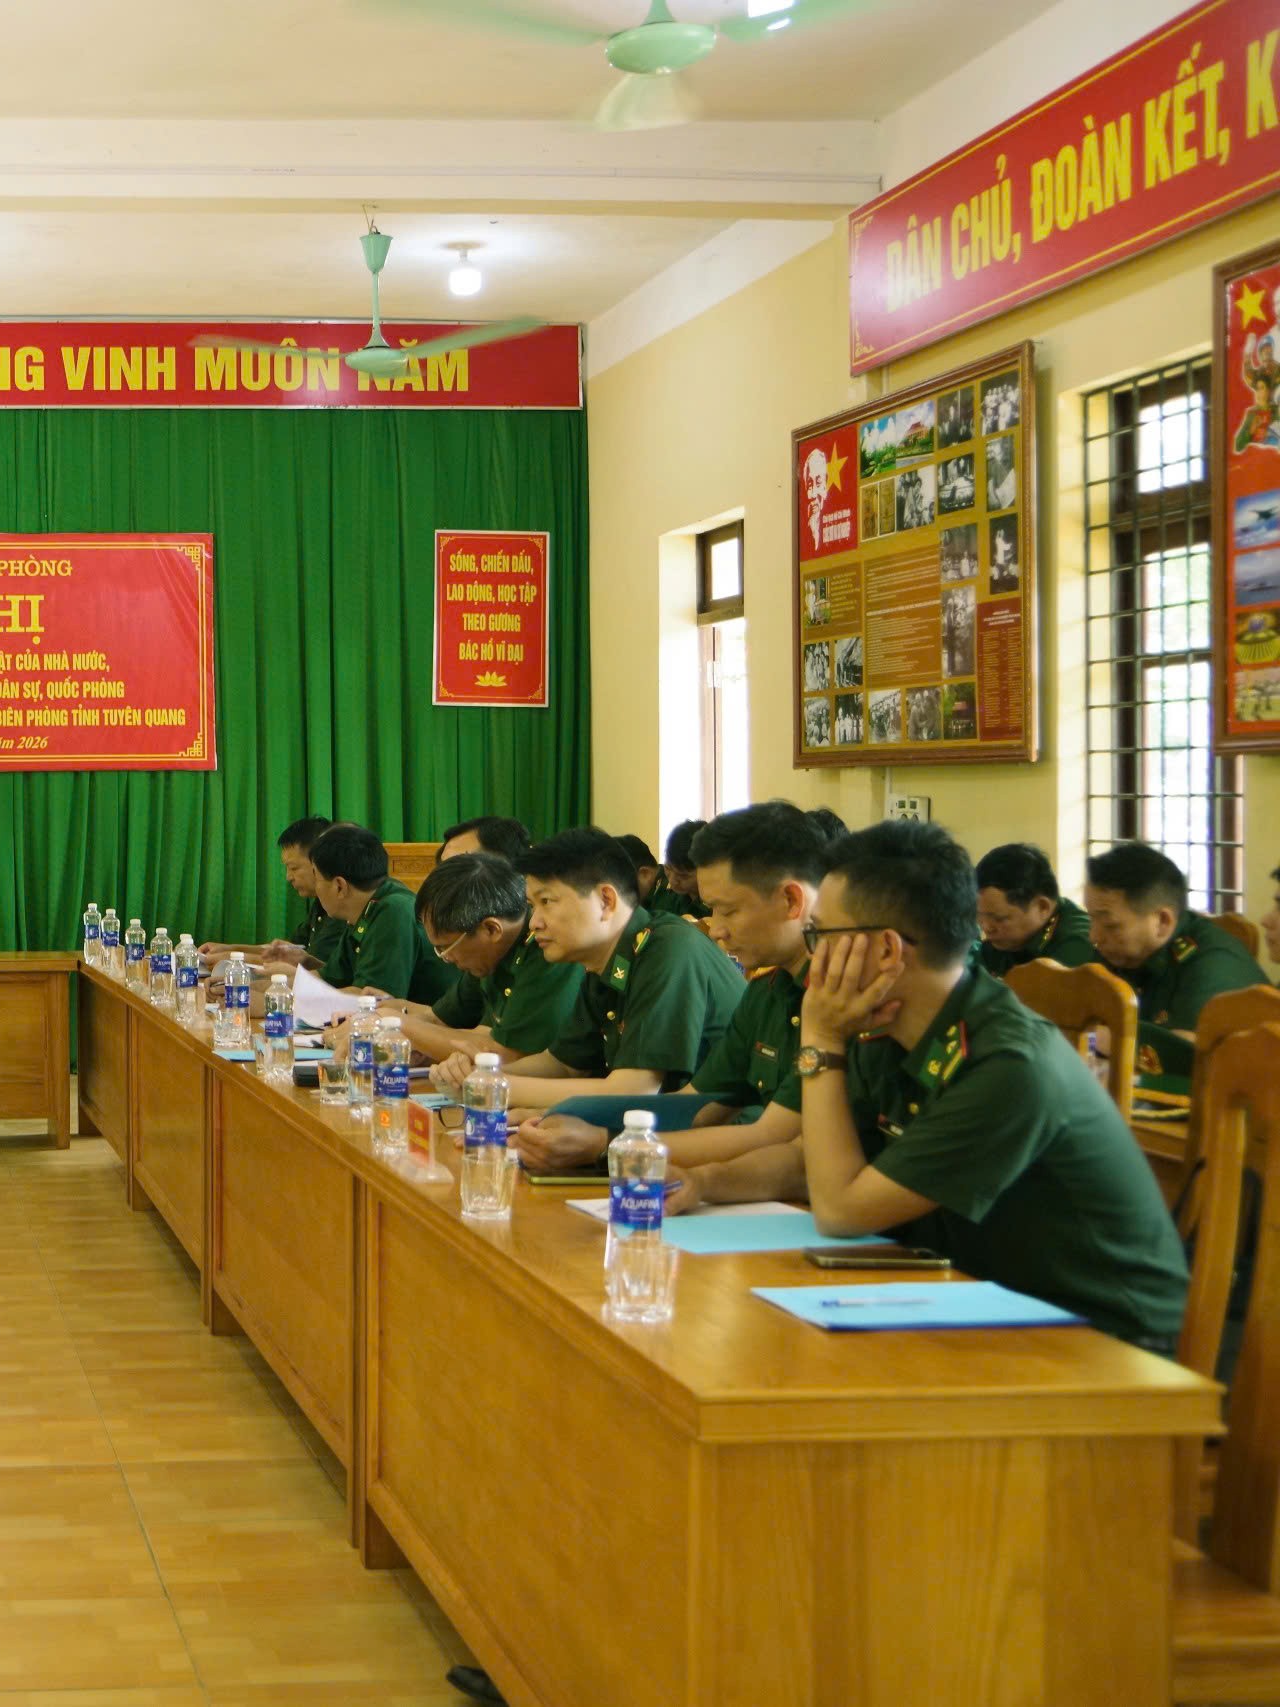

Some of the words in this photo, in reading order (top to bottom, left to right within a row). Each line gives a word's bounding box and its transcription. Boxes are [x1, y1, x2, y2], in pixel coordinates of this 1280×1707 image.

[887, 215, 942, 313] DÂN
[951, 154, 1021, 281] CHỦ,
[1030, 113, 1132, 244] ĐOÀN
[1144, 42, 1230, 190] KẾT,
[61, 347, 176, 391] VINH
[194, 337, 340, 392] MUÔN
[450, 548, 479, 574] SỐNG,
[481, 549, 510, 573] CHIẾN
[512, 549, 534, 575] ĐẤU,
[446, 583, 464, 602] LAO
[466, 580, 496, 605] ĐỘNG,
[497, 584, 517, 606] HỌC
[519, 582, 537, 606] TẬP
[462, 613, 486, 631] THEO
[489, 612, 521, 632] GƯƠNG
[15, 648, 40, 671] CỦA
[43, 650, 70, 671] NHÀ
[72, 650, 110, 672] NƯỚC,
[459, 639, 478, 660] BÁC
[480, 637, 494, 661] HỒ
[496, 640, 506, 661] VĨ
[507, 643, 524, 665] ĐẠI
[23, 680, 43, 702] SỰ,
[47, 676, 79, 700] QUỐC
[83, 677, 125, 698] PHÒNG
[26, 706, 68, 727] PHÒNG
[71, 704, 100, 726] TỈNH
[103, 706, 141, 726] TUYÊN
[145, 709, 186, 728] QUANG
[17, 736, 49, 749] 2026
